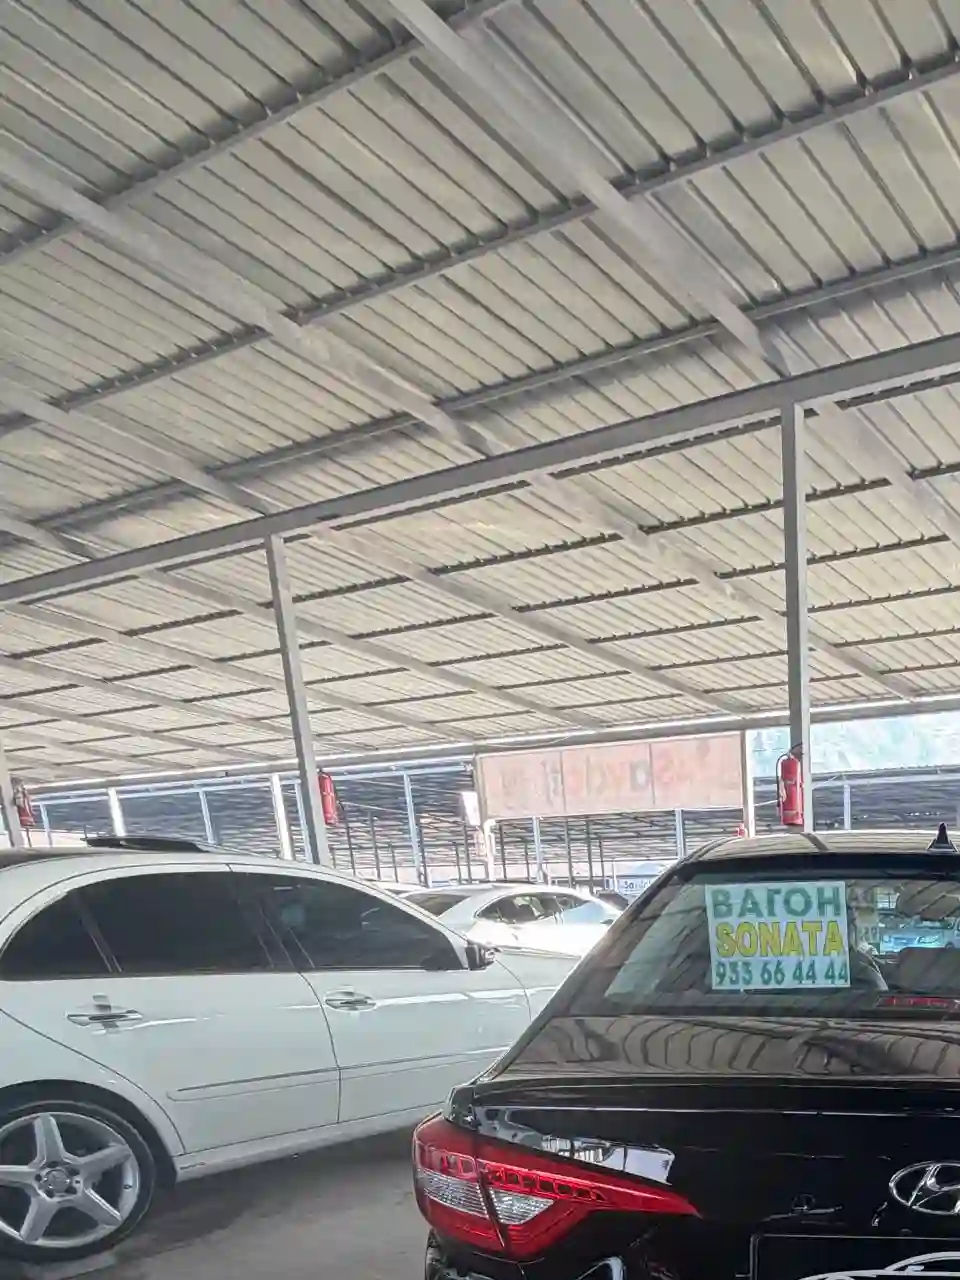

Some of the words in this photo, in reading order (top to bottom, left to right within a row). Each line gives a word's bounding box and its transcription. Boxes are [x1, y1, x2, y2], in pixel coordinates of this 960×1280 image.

[711, 886, 842, 918] ВАГОН
[715, 920, 846, 957] SONATA
[760, 961, 785, 985] 66
[792, 960, 817, 984] 44
[824, 959, 849, 984] 44
